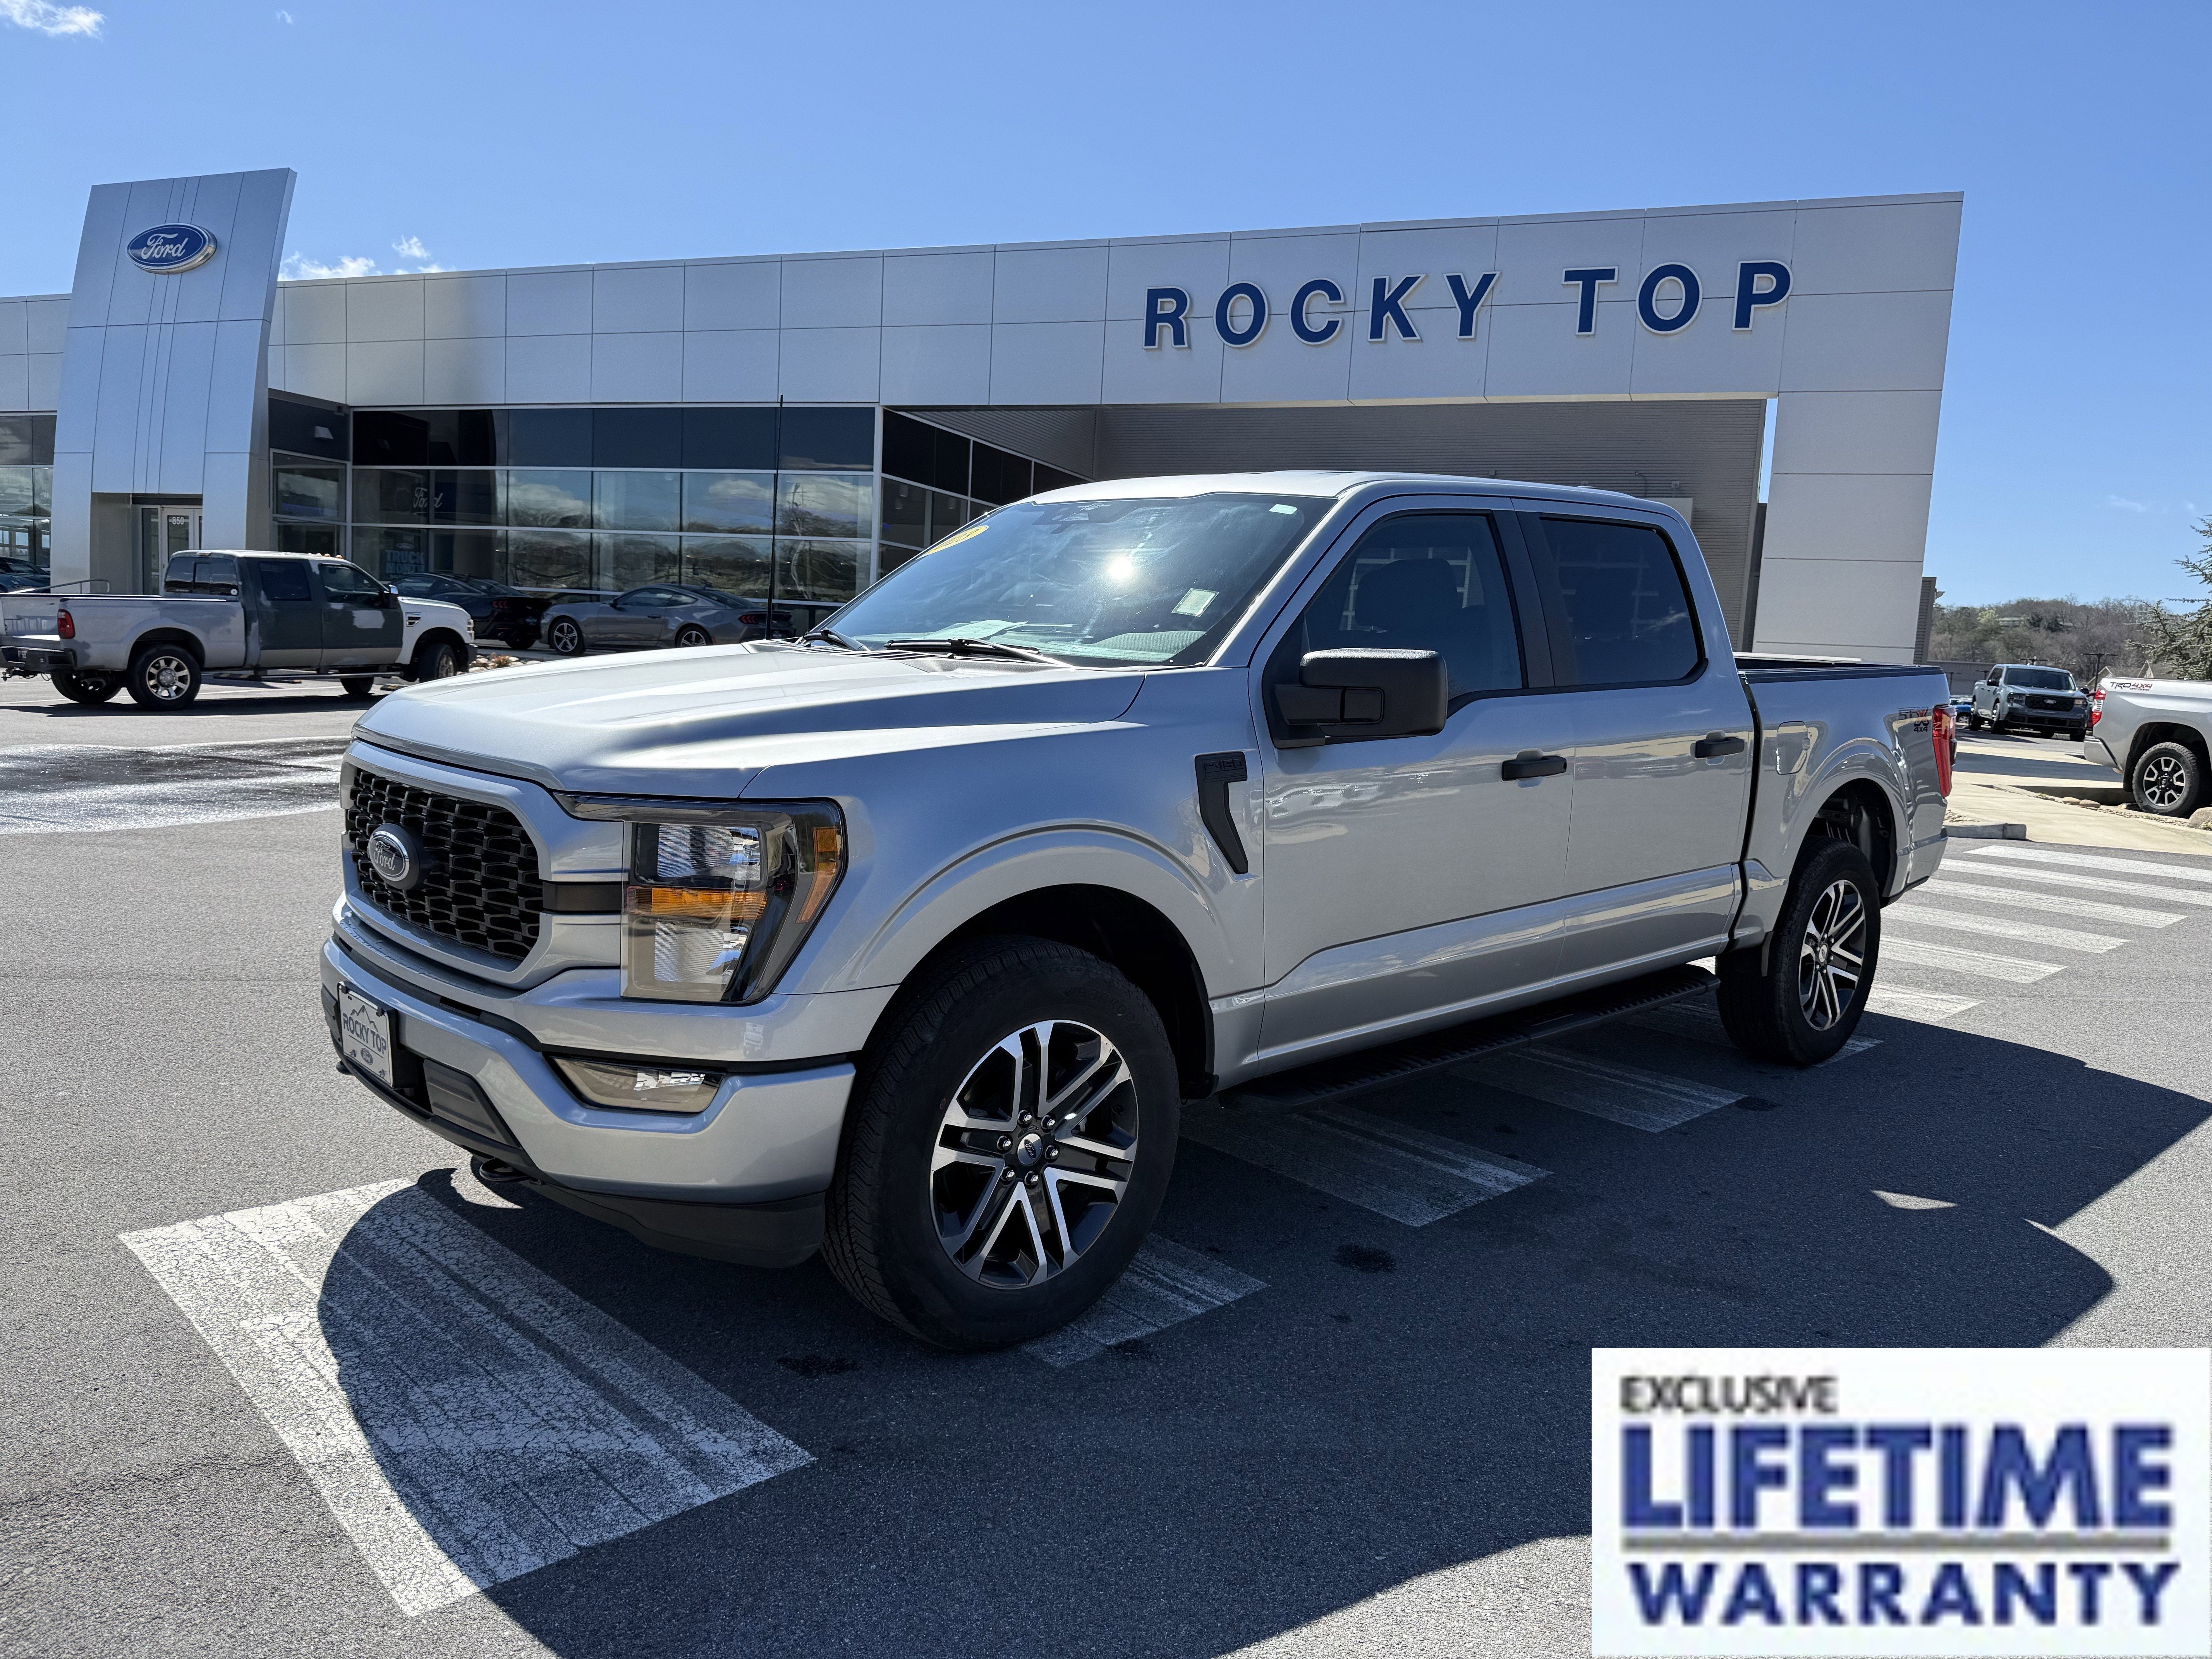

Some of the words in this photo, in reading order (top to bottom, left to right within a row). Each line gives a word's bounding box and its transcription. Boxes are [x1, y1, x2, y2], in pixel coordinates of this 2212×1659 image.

[141, 233, 189, 259] Ford
[1142, 271, 1501, 350] ROCKY
[1562, 260, 1794, 335] TOP
[172, 517, 184, 525] 850
[384, 550, 425, 566] TRUCK
[374, 840, 396, 870] Ford
[343, 1013, 368, 1044] ROCKY
[370, 1029, 387, 1054] TOP
